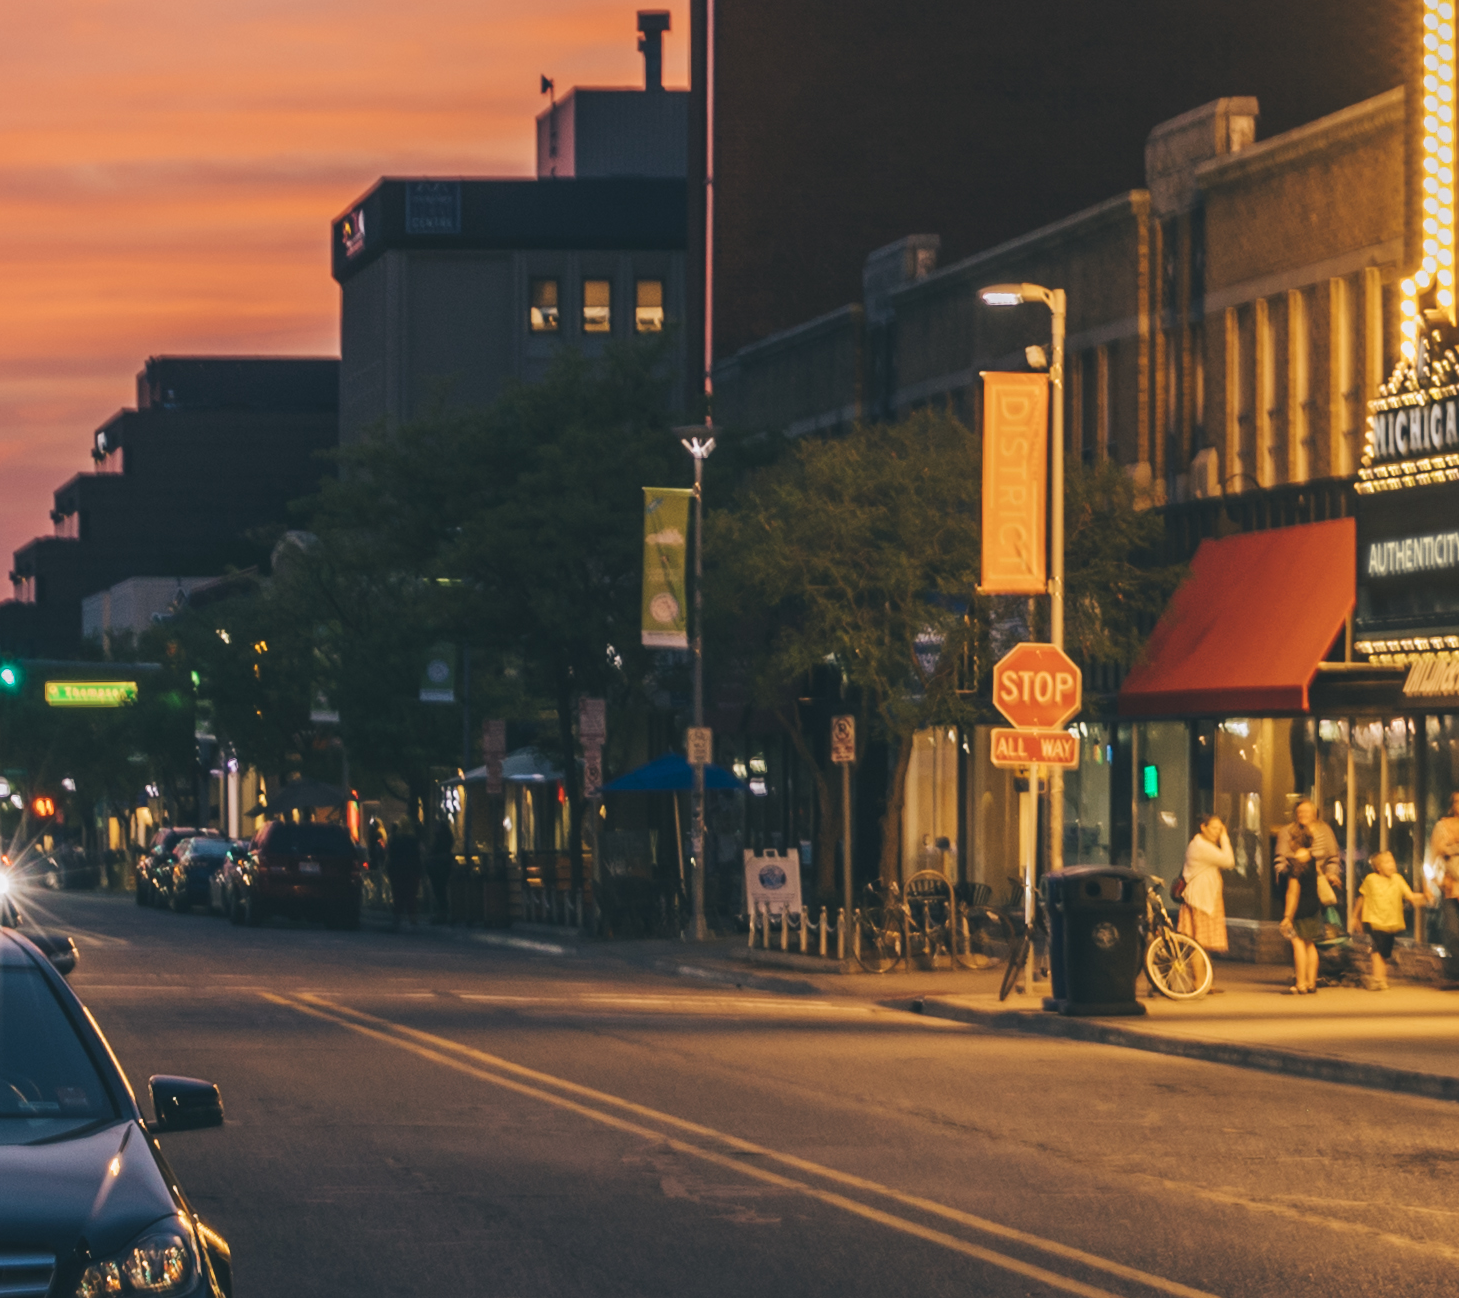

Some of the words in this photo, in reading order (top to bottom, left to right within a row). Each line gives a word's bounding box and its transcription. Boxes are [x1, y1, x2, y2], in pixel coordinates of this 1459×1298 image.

[999, 396, 1029, 571] DISTRICT
[999, 670, 1074, 704] STOP
[996, 737, 1032, 757] ALL
[1040, 738, 1073, 759] WAY
